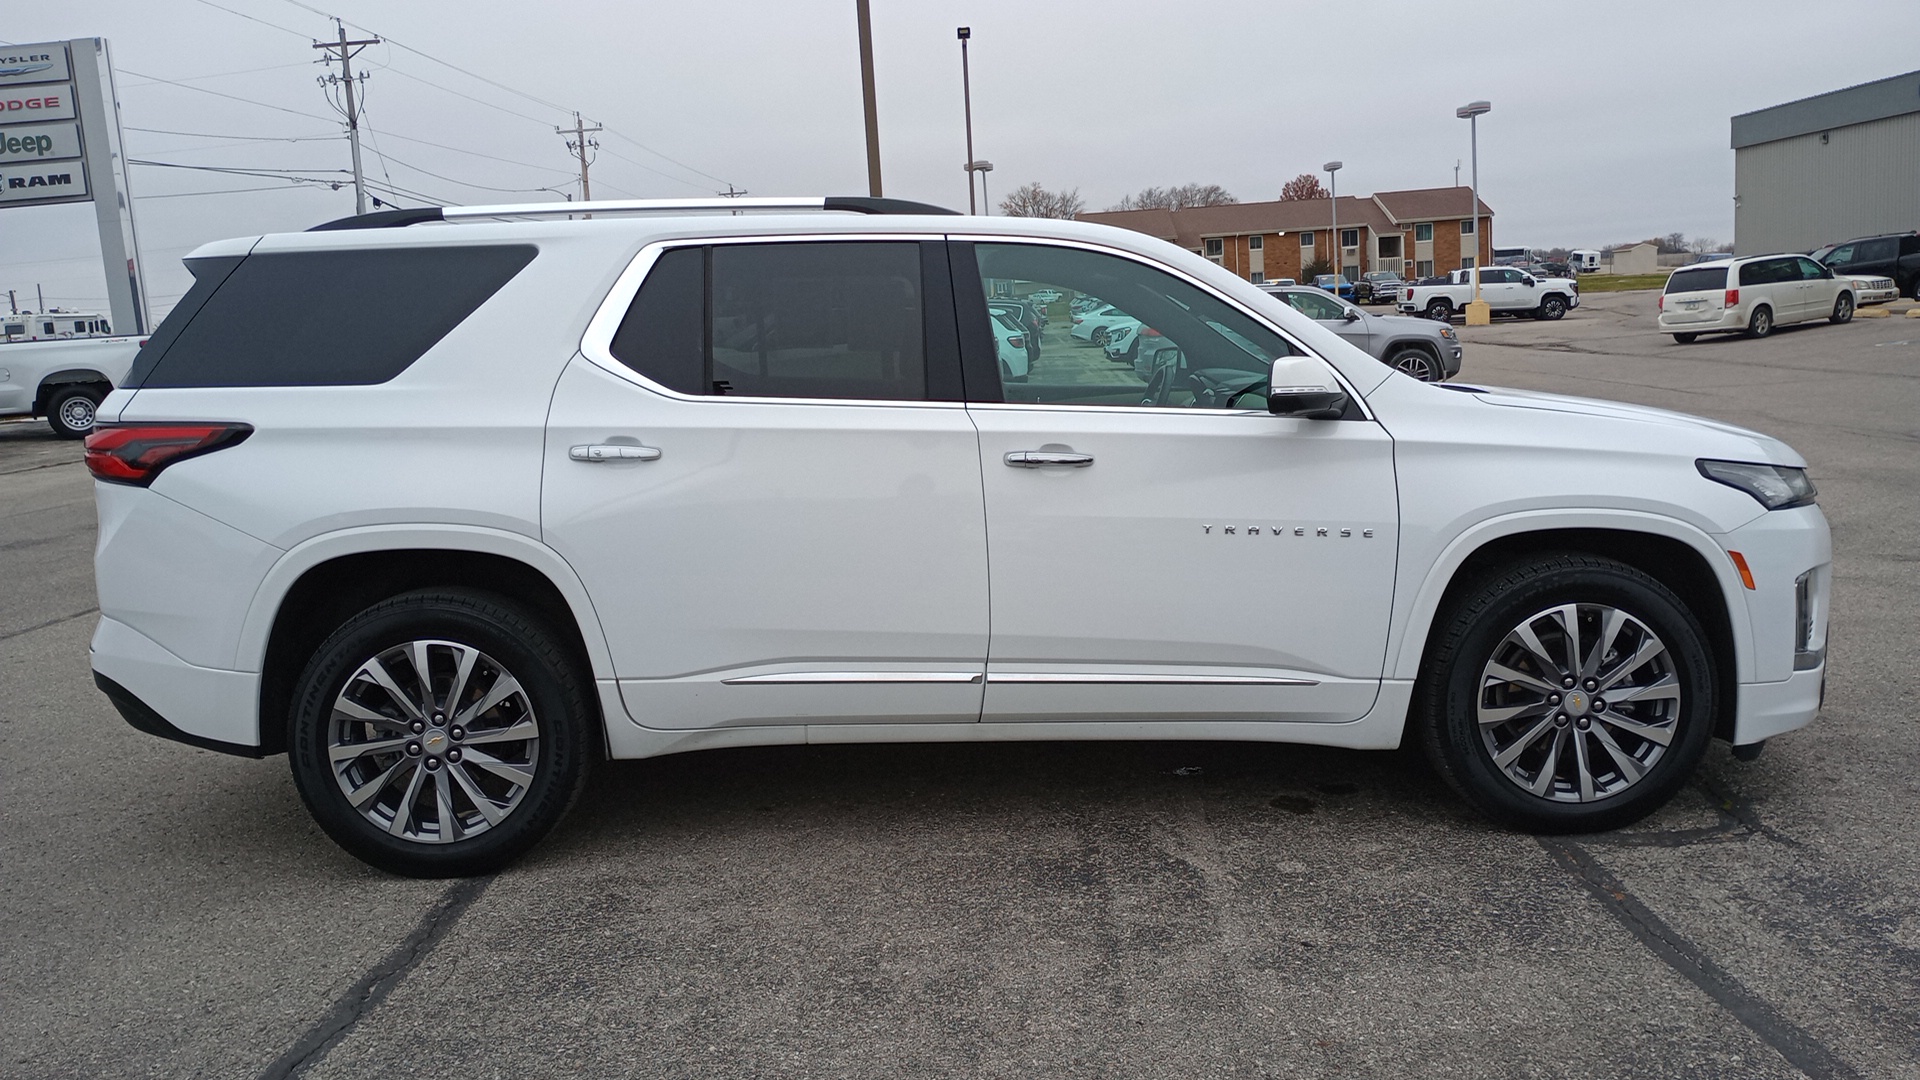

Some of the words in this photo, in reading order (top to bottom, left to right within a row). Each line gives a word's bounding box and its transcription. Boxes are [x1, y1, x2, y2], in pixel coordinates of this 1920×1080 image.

[0, 132, 52, 156] Jeep
[8, 173, 71, 189] RAM
[1202, 524, 1374, 538] TRAVERSE
